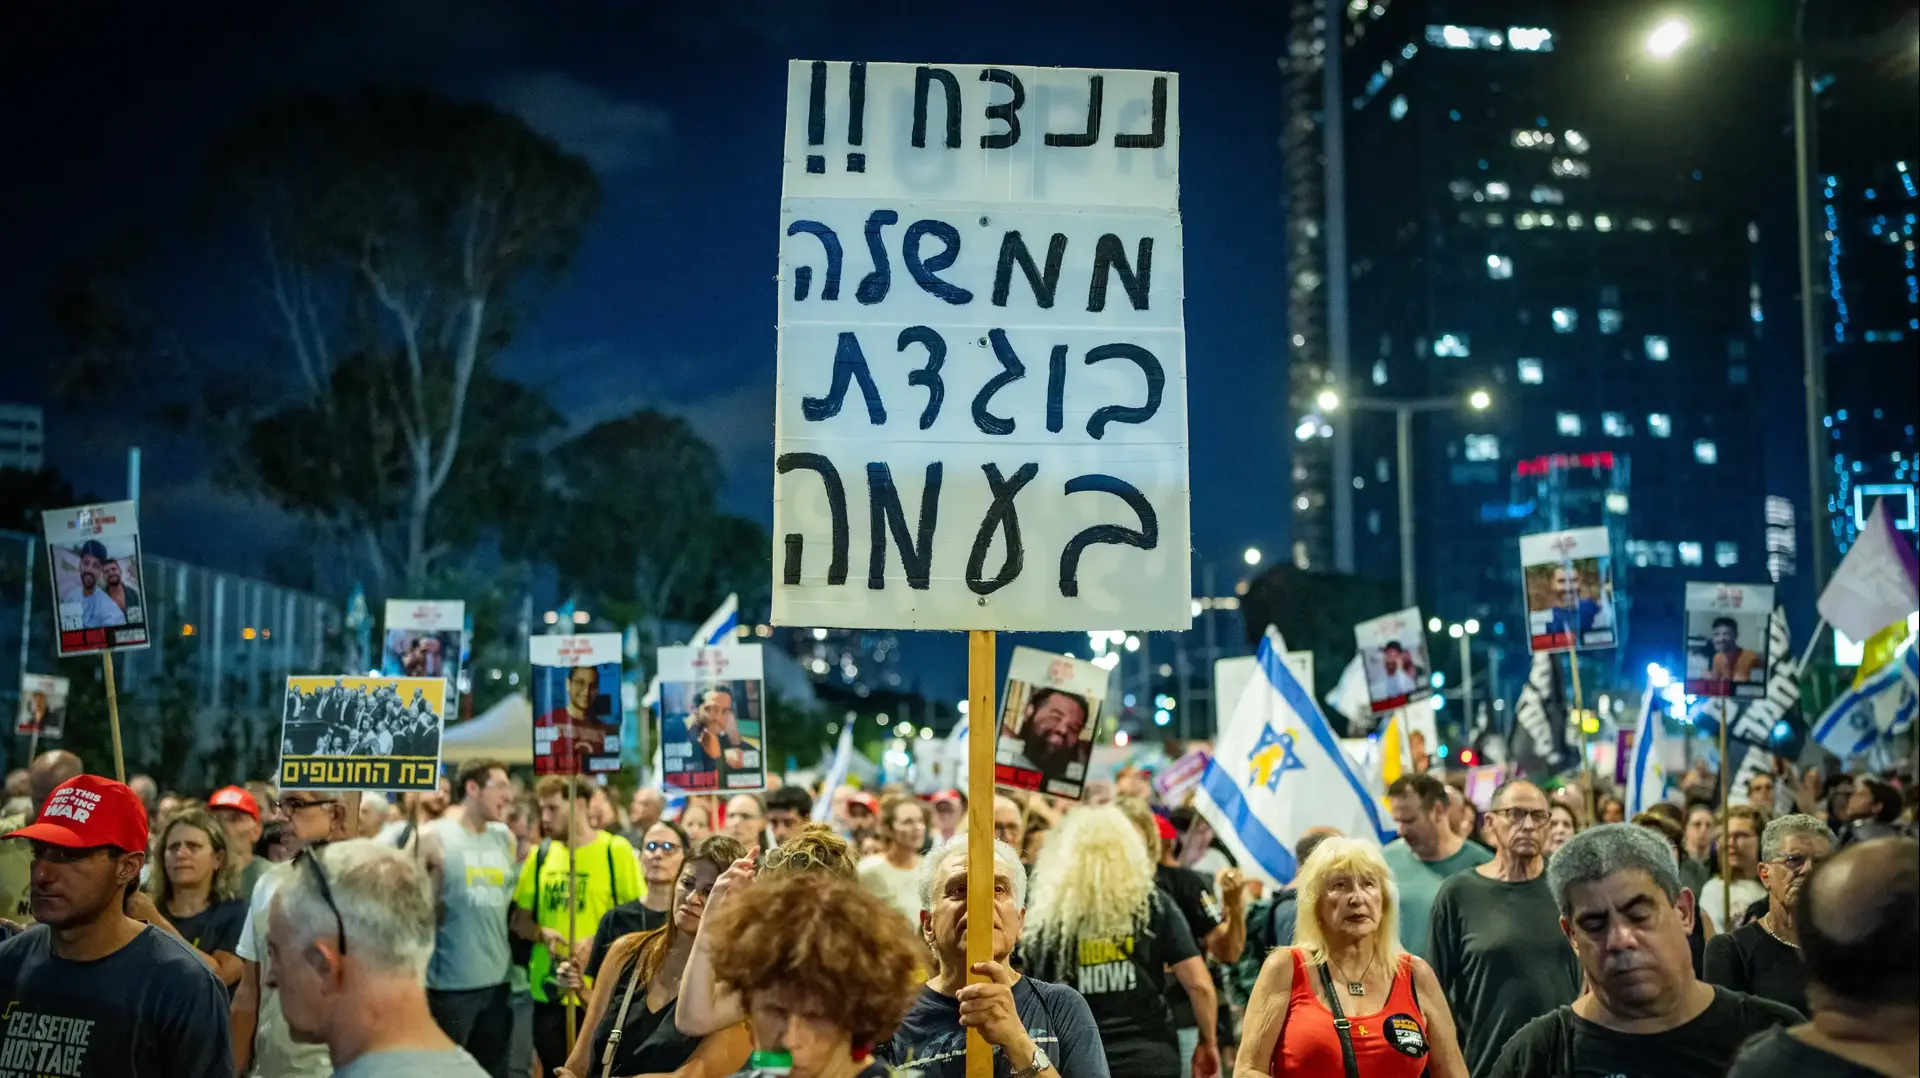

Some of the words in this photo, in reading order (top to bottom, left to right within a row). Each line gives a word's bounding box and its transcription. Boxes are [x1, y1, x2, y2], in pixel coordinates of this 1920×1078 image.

[787, 209, 1155, 312] ממשלה
[801, 325, 1166, 440] בוגדת
[777, 452, 1158, 598] בעמה
[283, 761, 390, 784] החוטפים
[398, 763, 435, 785] כת
[75, 788, 102, 803] THIS
[44, 804, 90, 824] WAR
[1078, 960, 1137, 994] NOW!
[7, 1011, 95, 1046] CEASEFIRE
[0, 1037, 87, 1078] HOSTAGE
